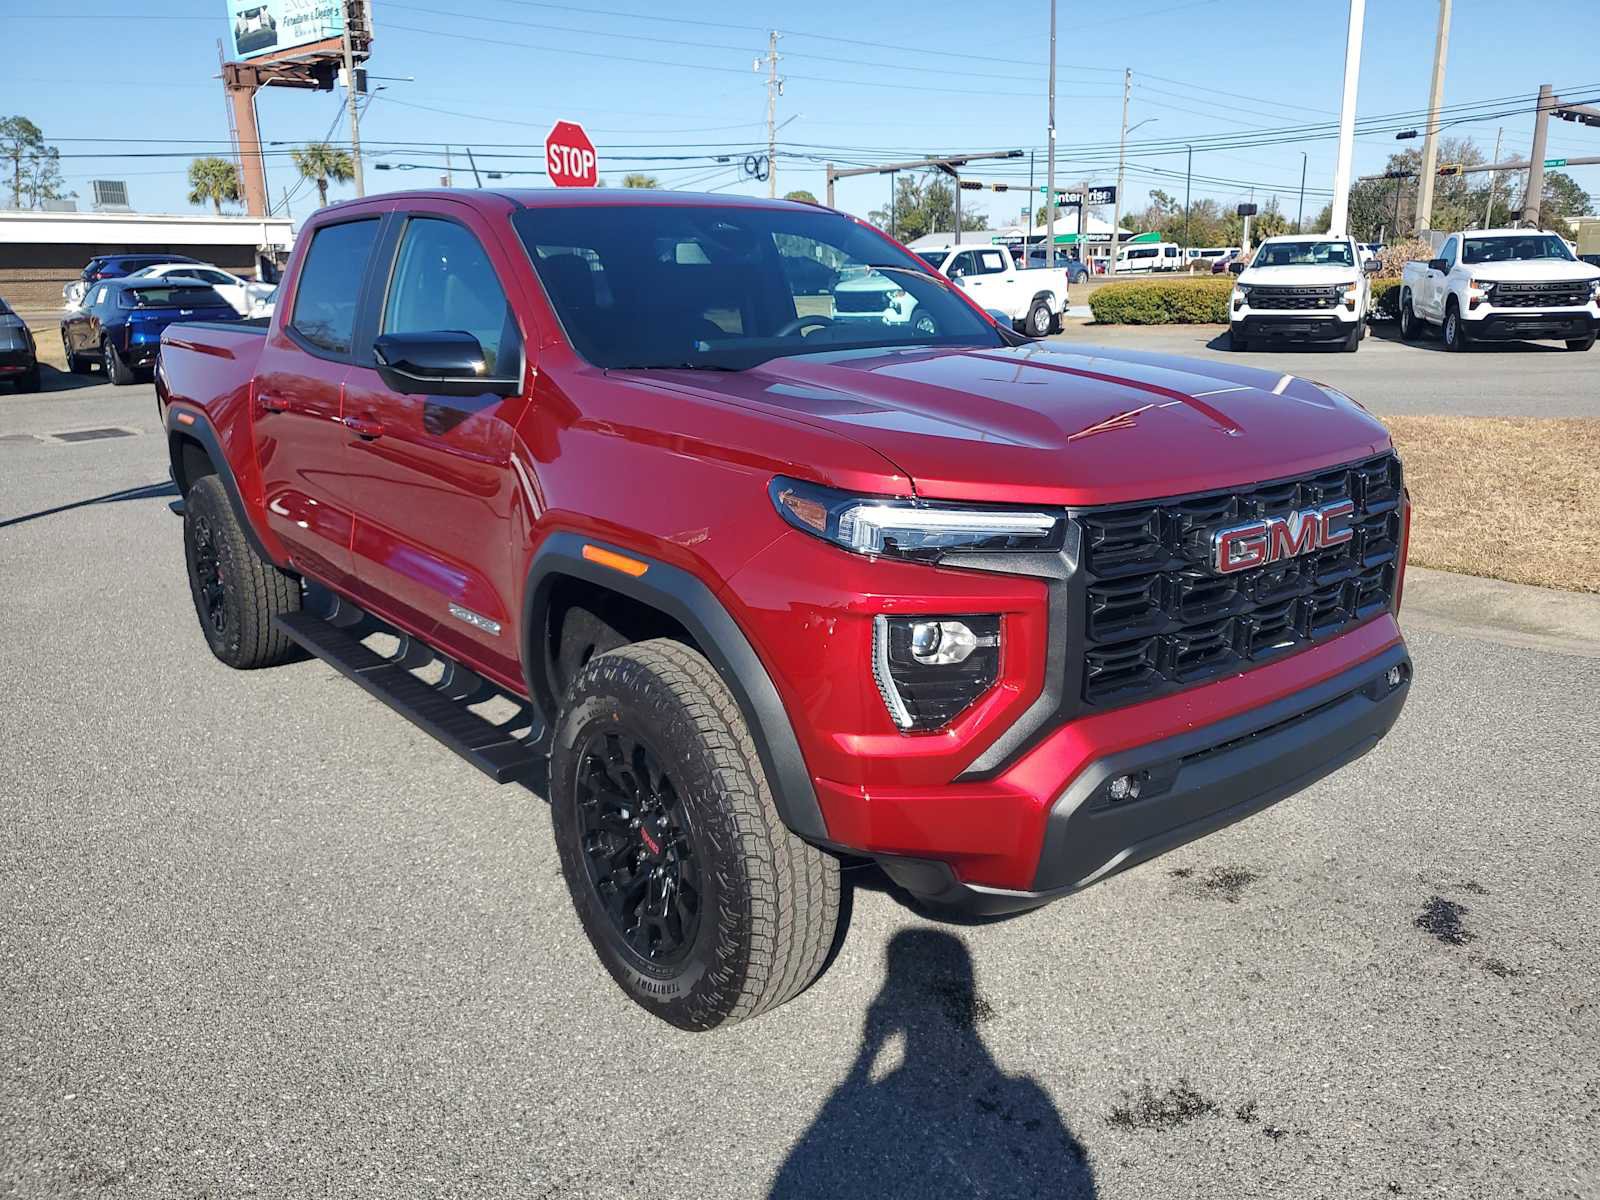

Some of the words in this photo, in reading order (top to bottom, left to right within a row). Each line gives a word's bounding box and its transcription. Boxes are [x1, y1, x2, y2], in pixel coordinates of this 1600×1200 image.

[549, 143, 595, 179] STOP
[1211, 499, 1354, 574] GMC
[635, 976, 681, 995] TERRITORY
